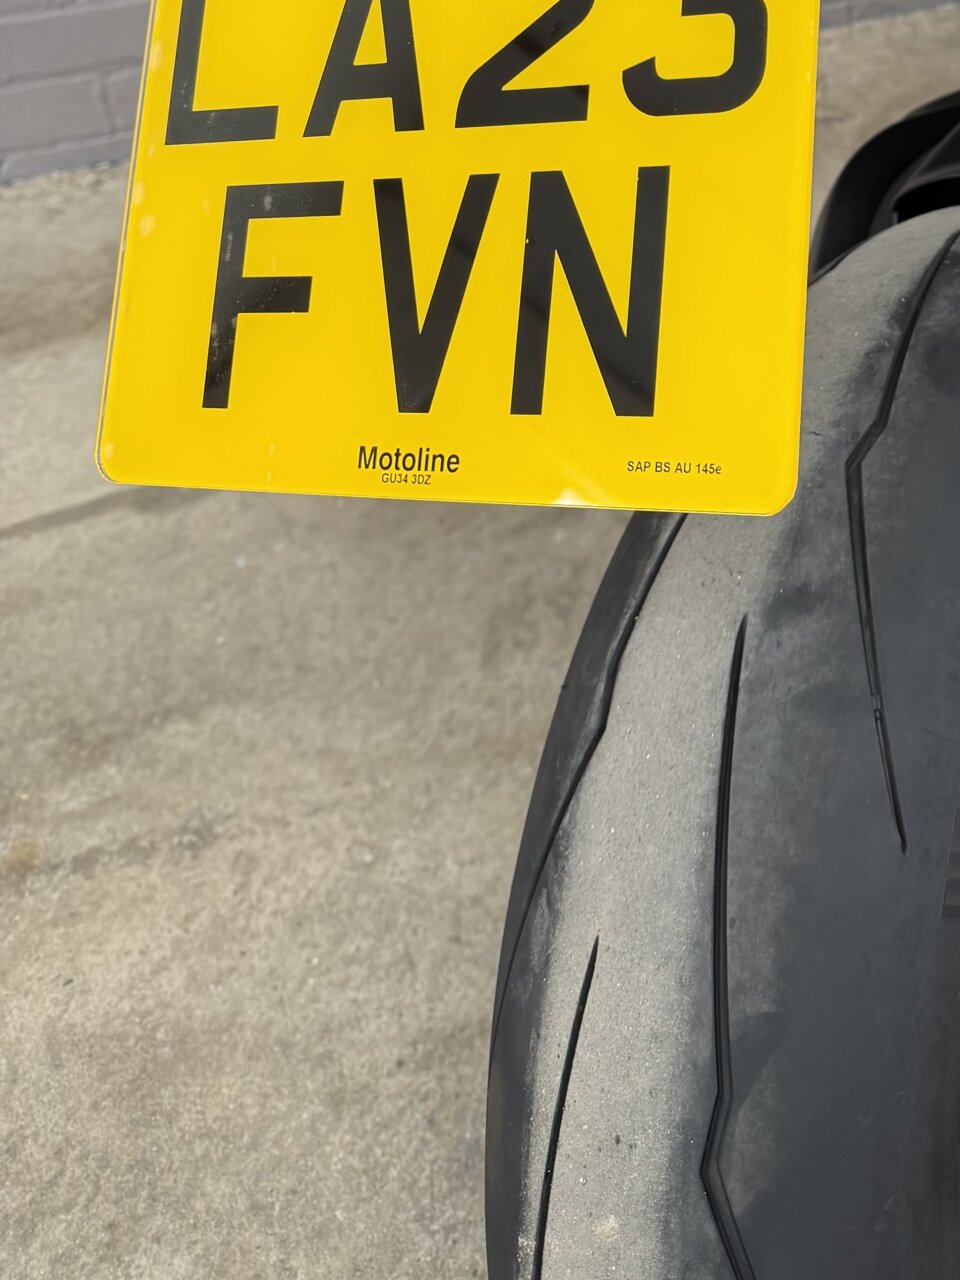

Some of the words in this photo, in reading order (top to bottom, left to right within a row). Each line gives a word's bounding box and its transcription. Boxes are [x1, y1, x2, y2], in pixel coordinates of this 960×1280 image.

[202, 165, 671, 417] FVN
[358, 446, 460, 473] Motoline
[627, 460, 651, 472] SAP
[655, 461, 671, 473] BS
[674, 462, 692, 474] AU
[696, 463, 722, 475] 145e
[381, 472, 408, 483] GU34
[411, 473, 432, 485] 3DZ
